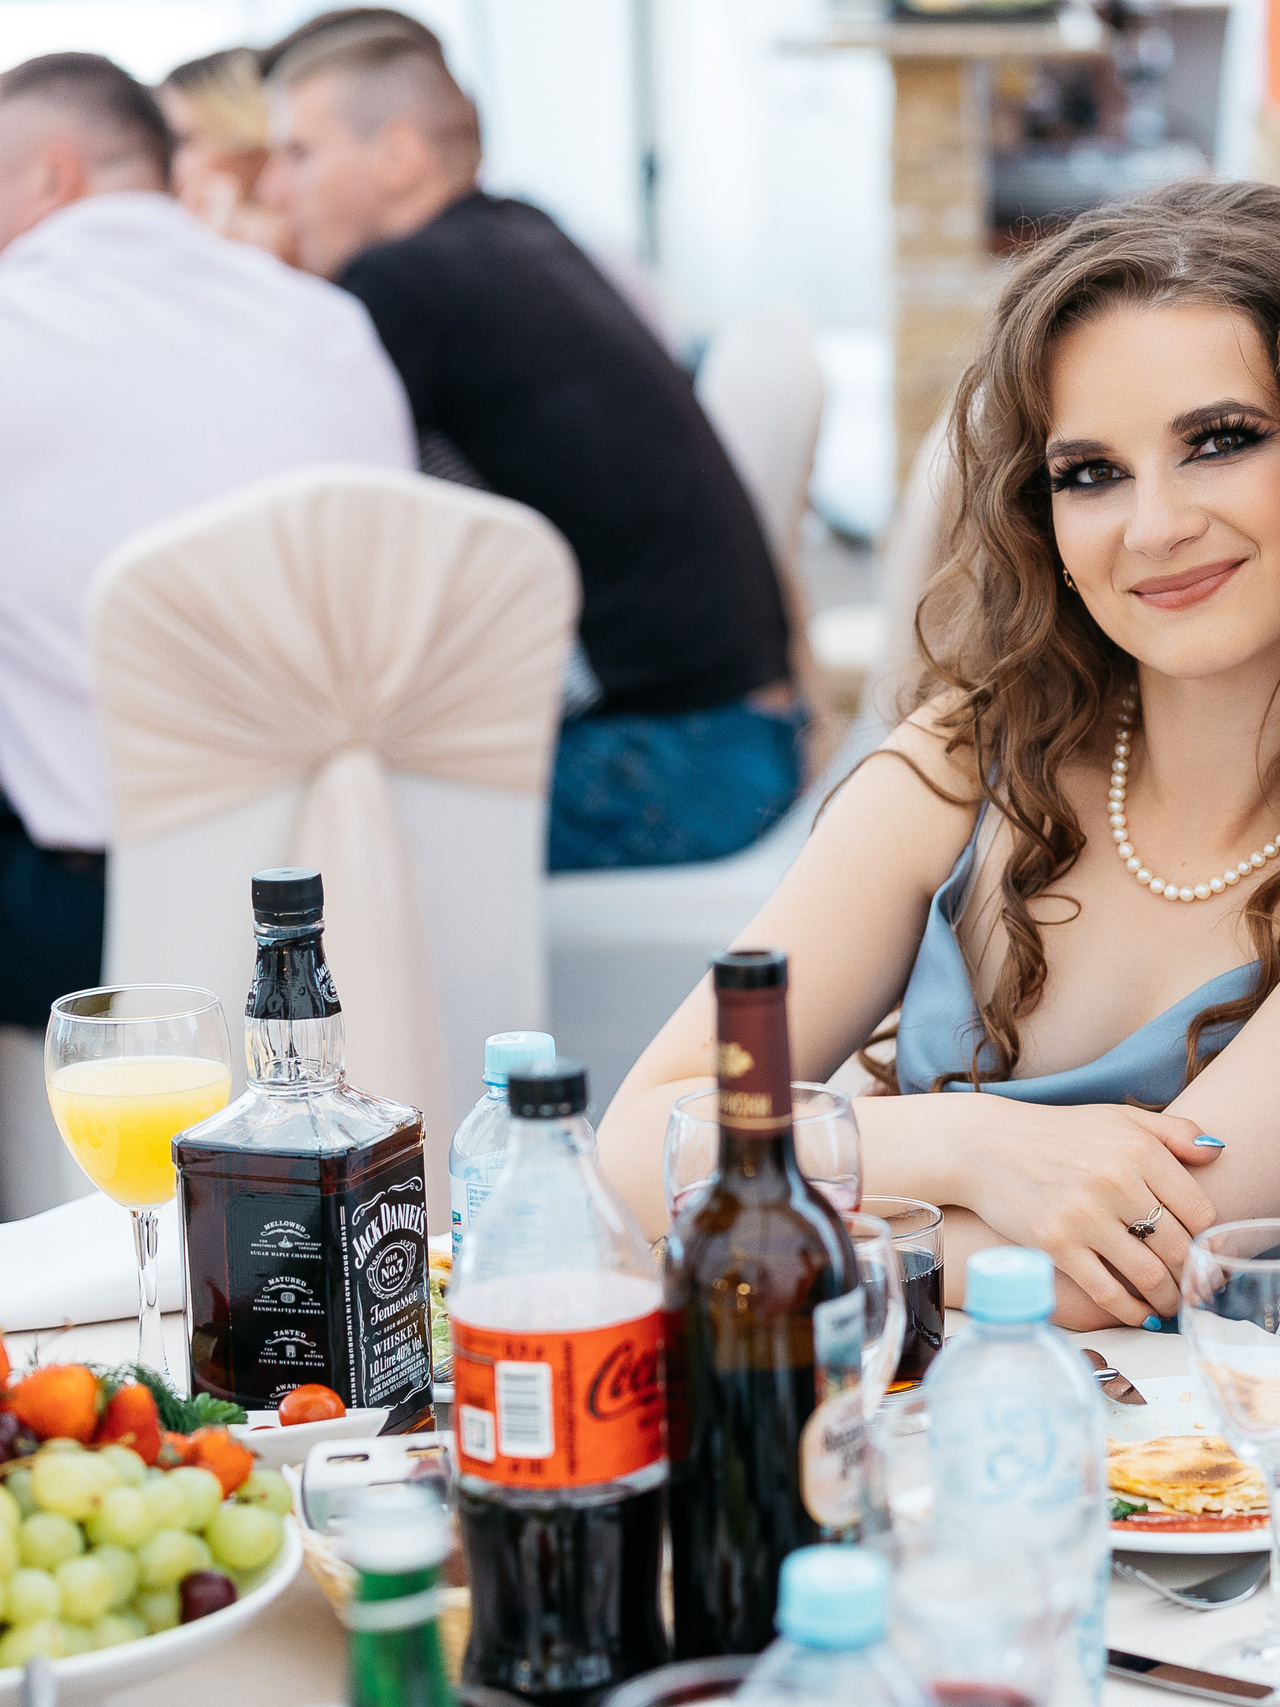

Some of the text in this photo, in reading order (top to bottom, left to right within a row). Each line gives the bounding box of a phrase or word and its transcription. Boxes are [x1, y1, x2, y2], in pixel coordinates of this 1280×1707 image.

[263, 1220, 306, 1233] MELLOWED
[340, 1225, 348, 1253] EVERY
[352, 1202, 427, 1269] JACK DANIEL'S
[342, 1254, 350, 1278] DROP
[385, 1252, 397, 1264] Old
[268, 1276, 307, 1287] MATURED
[252, 1306, 297, 1314] HANDCRAFTED
[345, 1304, 352, 1314] IN
[370, 1290, 418, 1326] Tennessee
[273, 1329, 307, 1339] TASTED
[373, 1320, 419, 1356] WHISKEY
[383, 1315, 409, 1334] SOUR MASH
[346, 1315, 355, 1366] LYNCHBURG
[380, 1354, 396, 1372] Litre
[396, 1341, 412, 1362] 40%
[411, 1334, 424, 1354] Vol.
[369, 1383, 381, 1397] JACK
[381, 1373, 399, 1389] DANIEL
[398, 1357, 426, 1379] DISTILLERY
[373, 1351, 421, 1385] DISTILLED AND BOTTLED BY
[349, 1366, 357, 1409] TENNESSE
